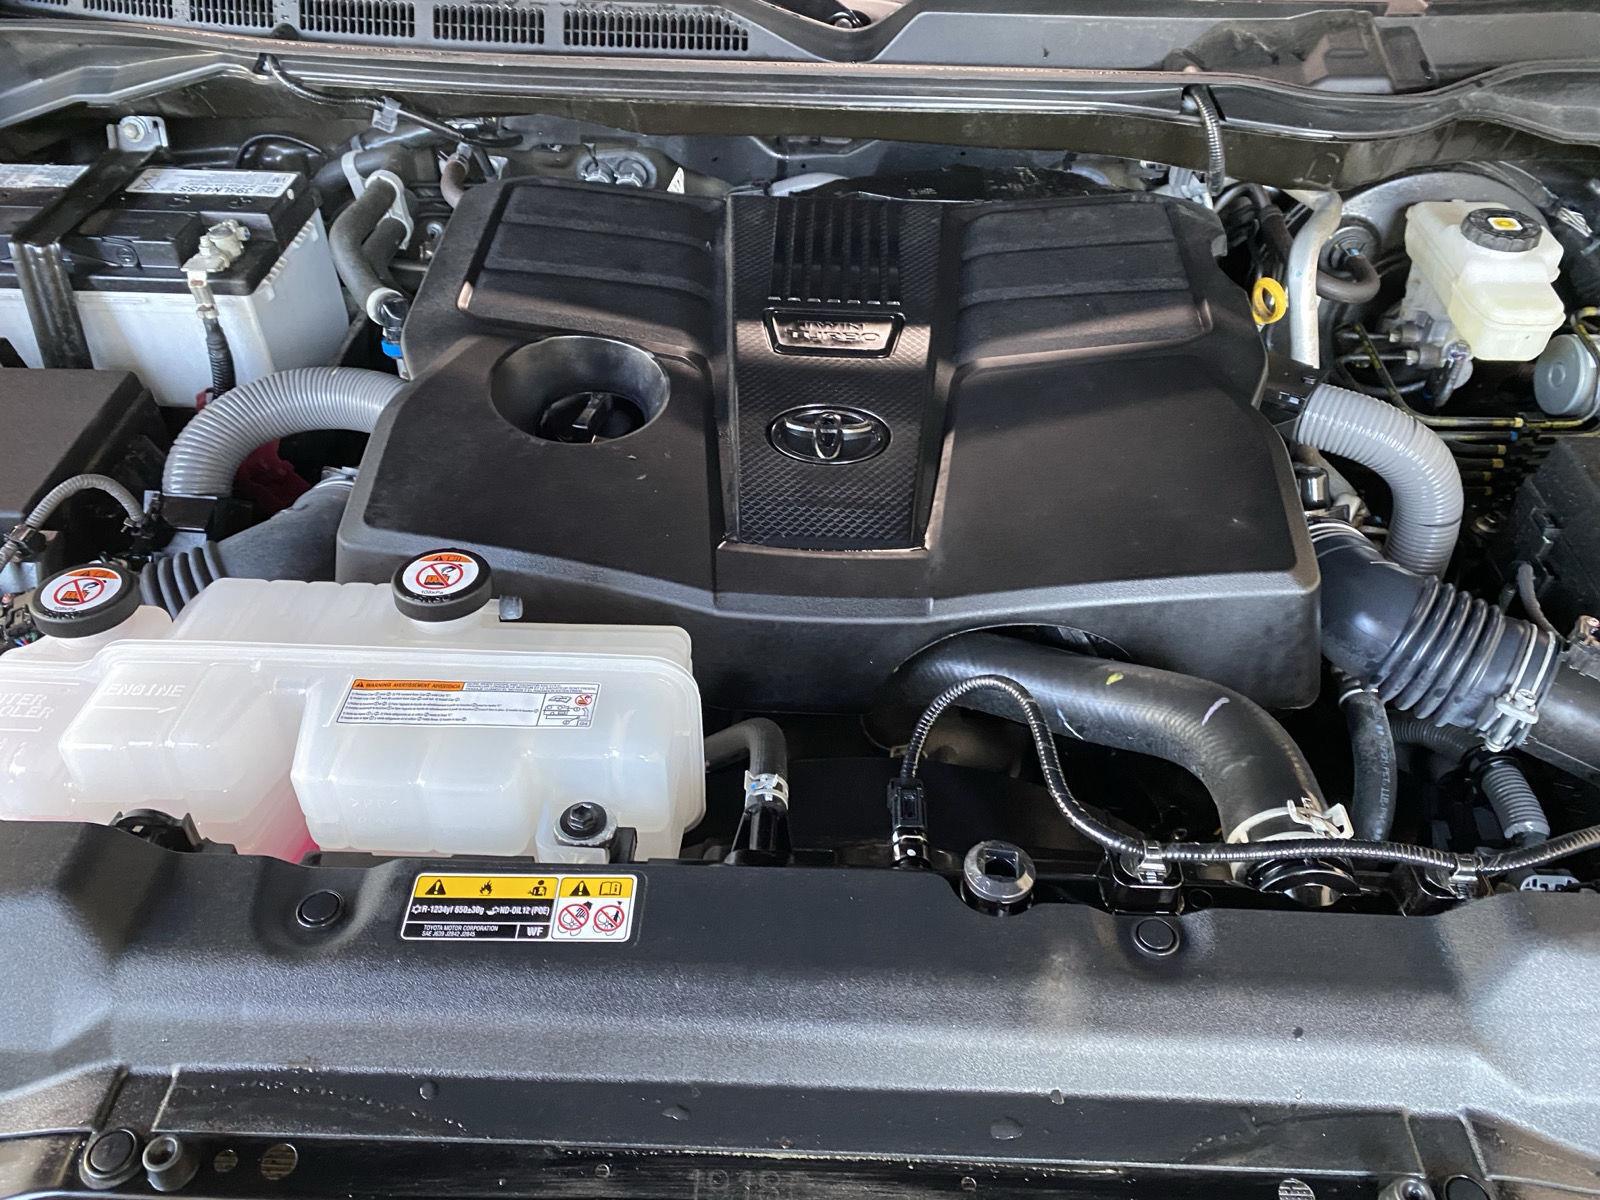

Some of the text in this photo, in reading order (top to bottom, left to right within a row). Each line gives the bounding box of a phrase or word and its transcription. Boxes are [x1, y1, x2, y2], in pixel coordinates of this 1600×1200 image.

[798, 320, 865, 330] TWIN
[785, 328, 880, 341] TURBO
[106, 683, 186, 697] ENGINE
[422, 905, 453, 915] R-1234yf
[531, 906, 550, 915] (POE)
[527, 926, 544, 936] WF
